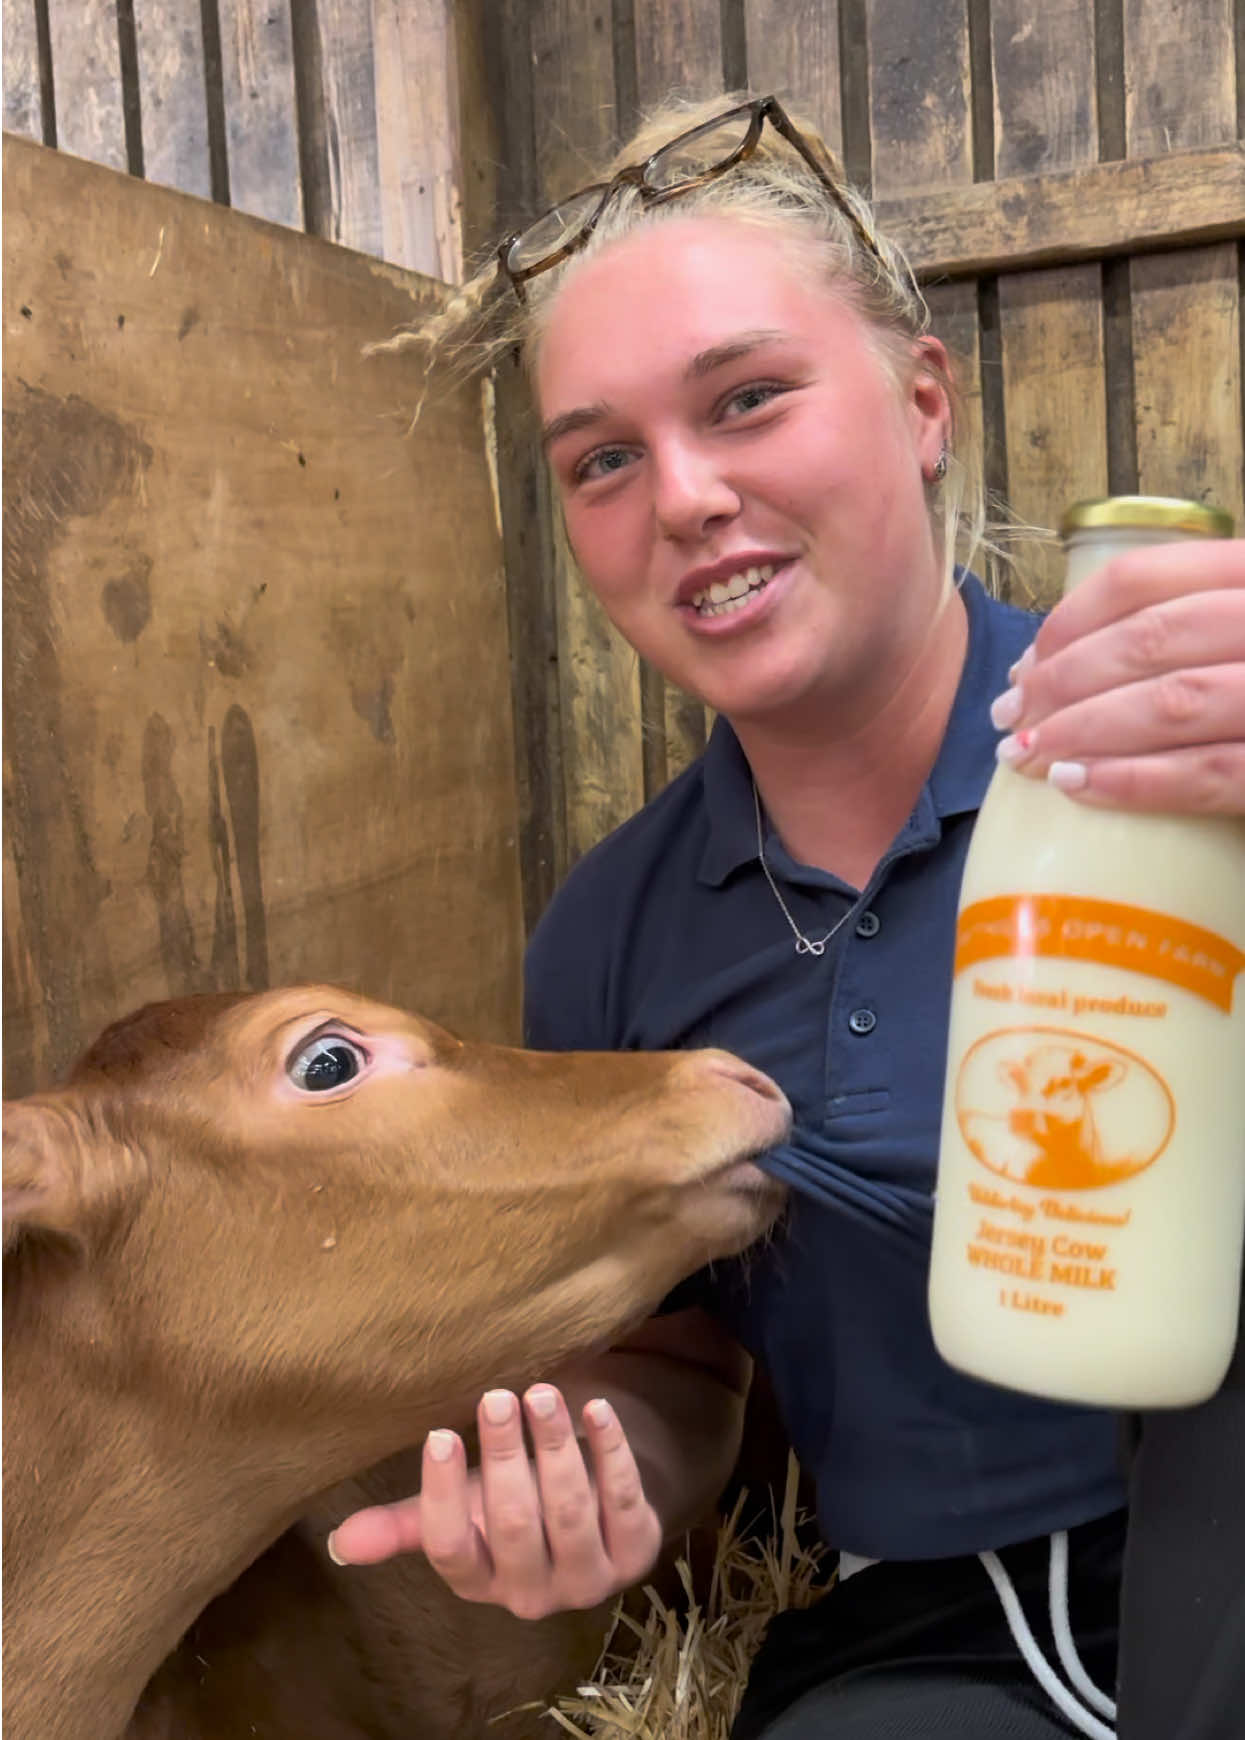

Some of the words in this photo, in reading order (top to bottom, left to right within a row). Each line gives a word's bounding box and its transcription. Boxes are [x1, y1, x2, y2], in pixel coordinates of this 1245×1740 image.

[1061, 917, 1149, 950] OPEN
[1073, 994, 1168, 1019] produce
[976, 1218, 1046, 1254] Jersey
[1051, 1234, 1108, 1261] Cow
[966, 1242, 1045, 1281] WHOLE
[1050, 1263, 1117, 1291] MILK
[1011, 1290, 1066, 1317] Litre
